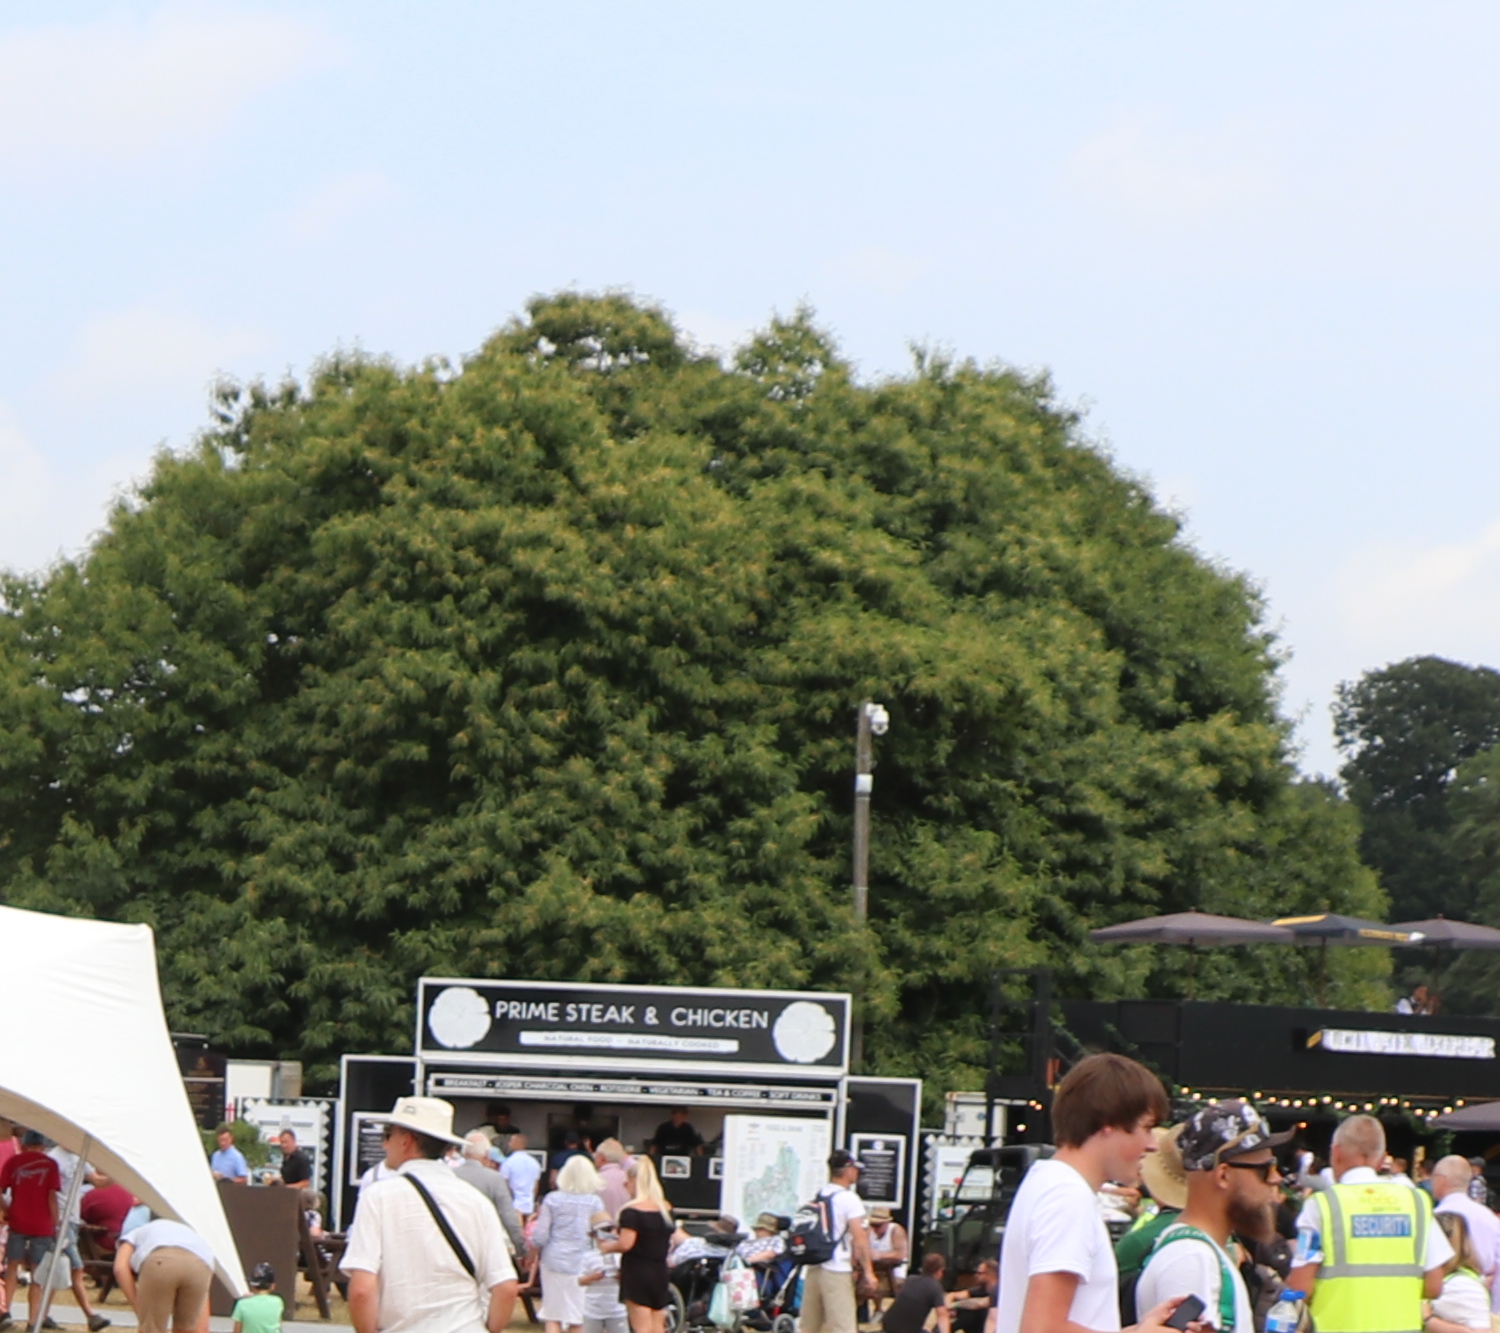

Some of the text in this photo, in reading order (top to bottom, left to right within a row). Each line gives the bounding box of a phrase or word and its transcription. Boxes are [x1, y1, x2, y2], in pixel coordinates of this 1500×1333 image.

[495, 1001, 769, 1029] PRIME STEAK & CHICKEN
[543, 1034, 585, 1043] NATURAL
[627, 1038, 680, 1047] NATURALLY
[1352, 1214, 1411, 1236] SECURITY
